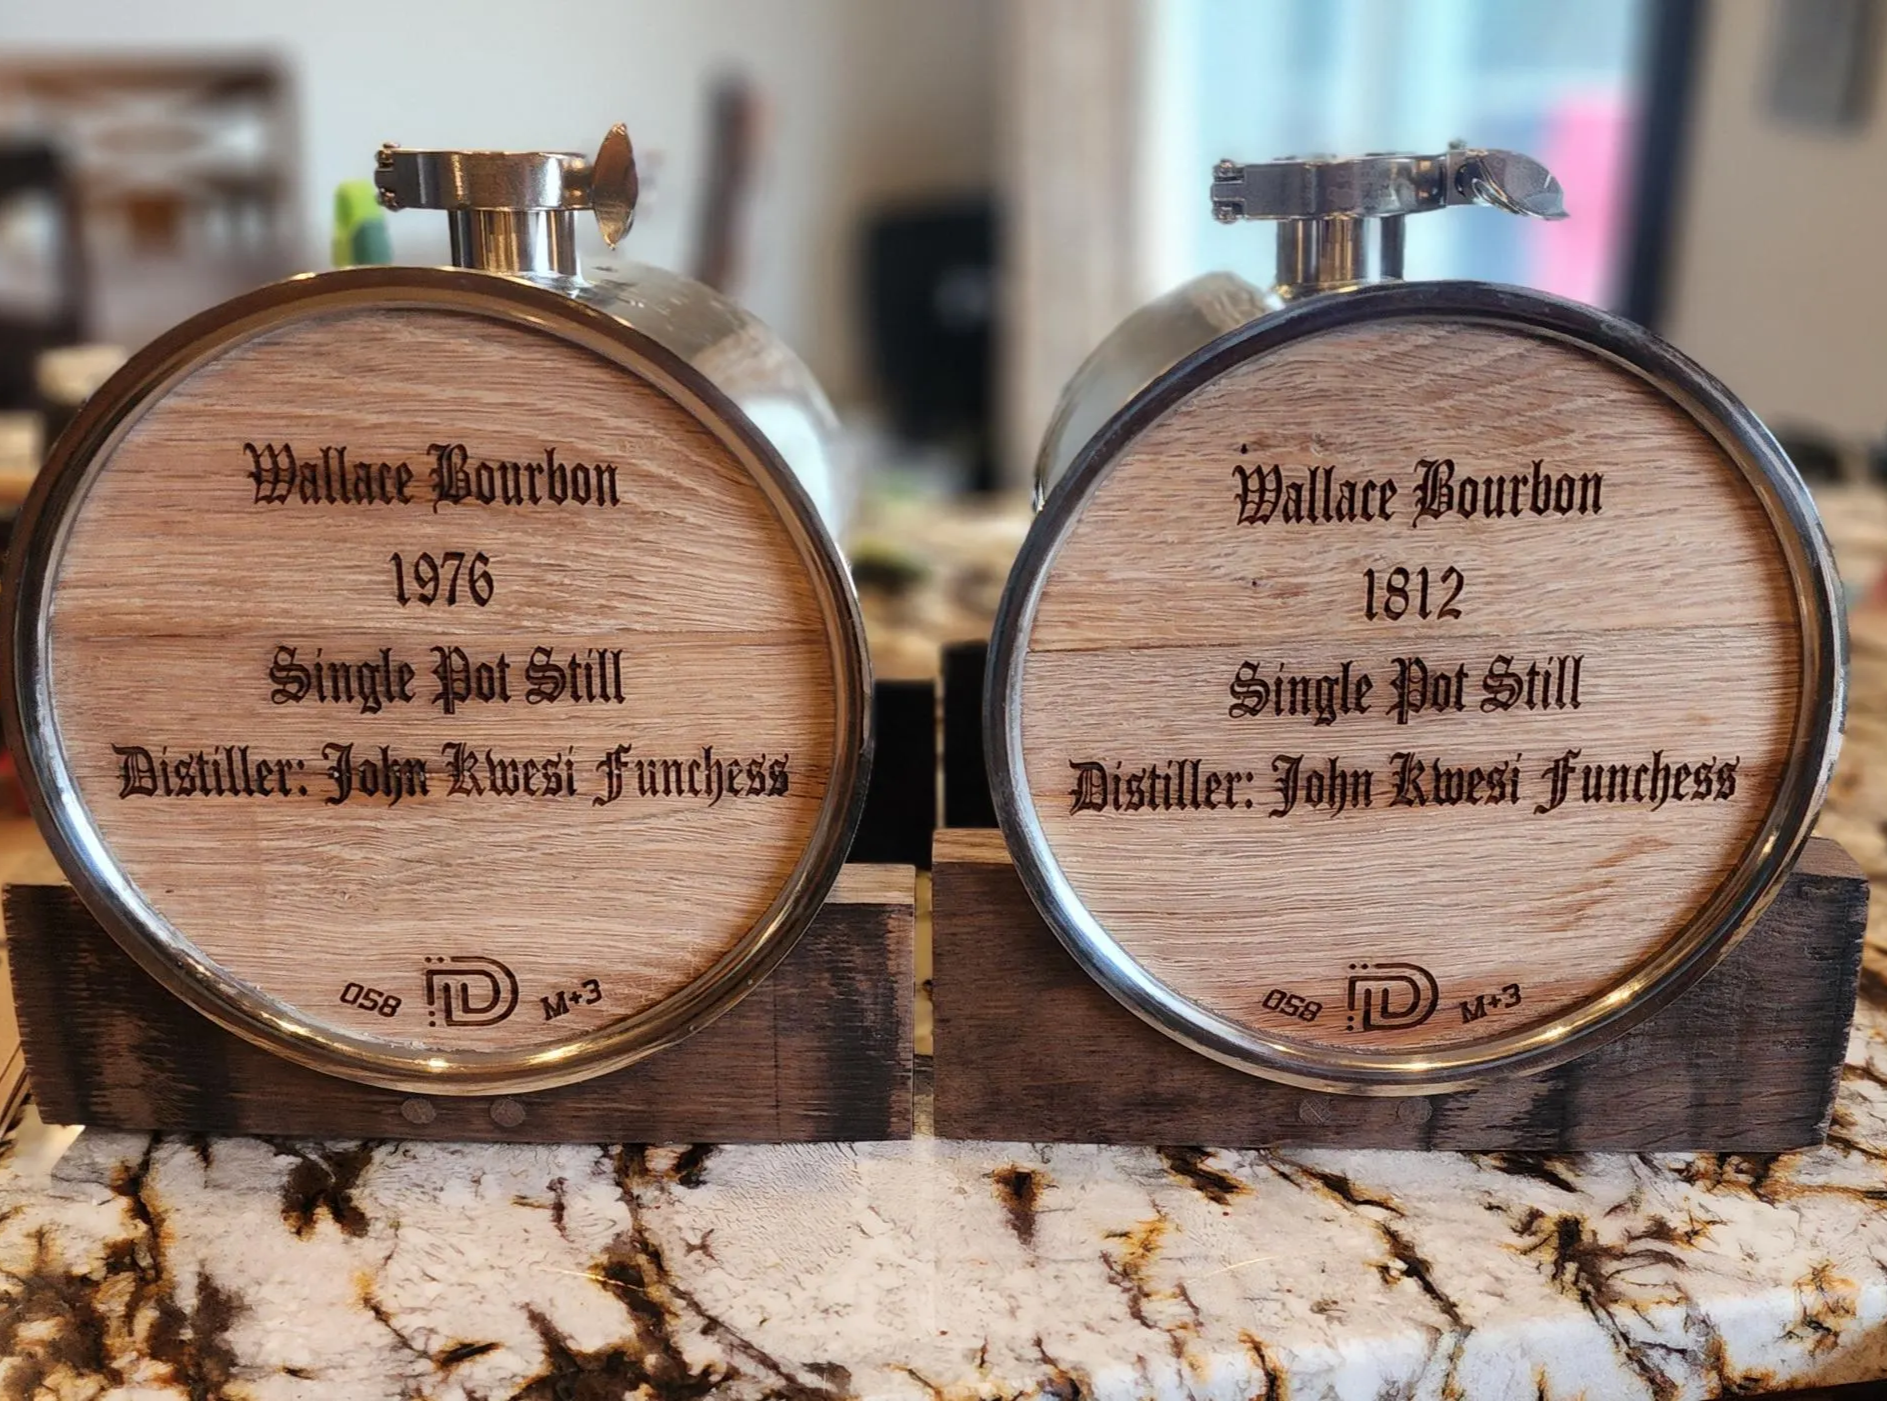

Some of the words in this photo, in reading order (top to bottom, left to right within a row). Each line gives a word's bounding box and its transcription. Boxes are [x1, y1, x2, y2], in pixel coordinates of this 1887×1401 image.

[244, 442, 414, 504] Wallace
[428, 444, 621, 514] Bourbon
[1232, 464, 1398, 527] Wallace
[1412, 459, 1603, 527] Bourbon
[389, 552, 494, 607] 1976
[1363, 566, 1465, 622] 1812
[269, 646, 415, 714] Single
[431, 646, 511, 714] Pot
[525, 647, 626, 705] Still
[1228, 661, 1374, 726] Single
[1388, 657, 1469, 724] Pot
[1480, 654, 1584, 712] Still
[112, 743, 308, 800] Distiller:
[324, 742, 429, 807] John
[442, 742, 575, 798] Kwesi
[592, 743, 791, 807] Funchess
[1069, 759, 1254, 815] Distiller:
[1269, 754, 1374, 818] John
[1388, 751, 1522, 803] Kwesi
[1534, 748, 1741, 814] Funchess
[539, 978, 603, 1022] M+3
[1459, 983, 1522, 1024] M+3
